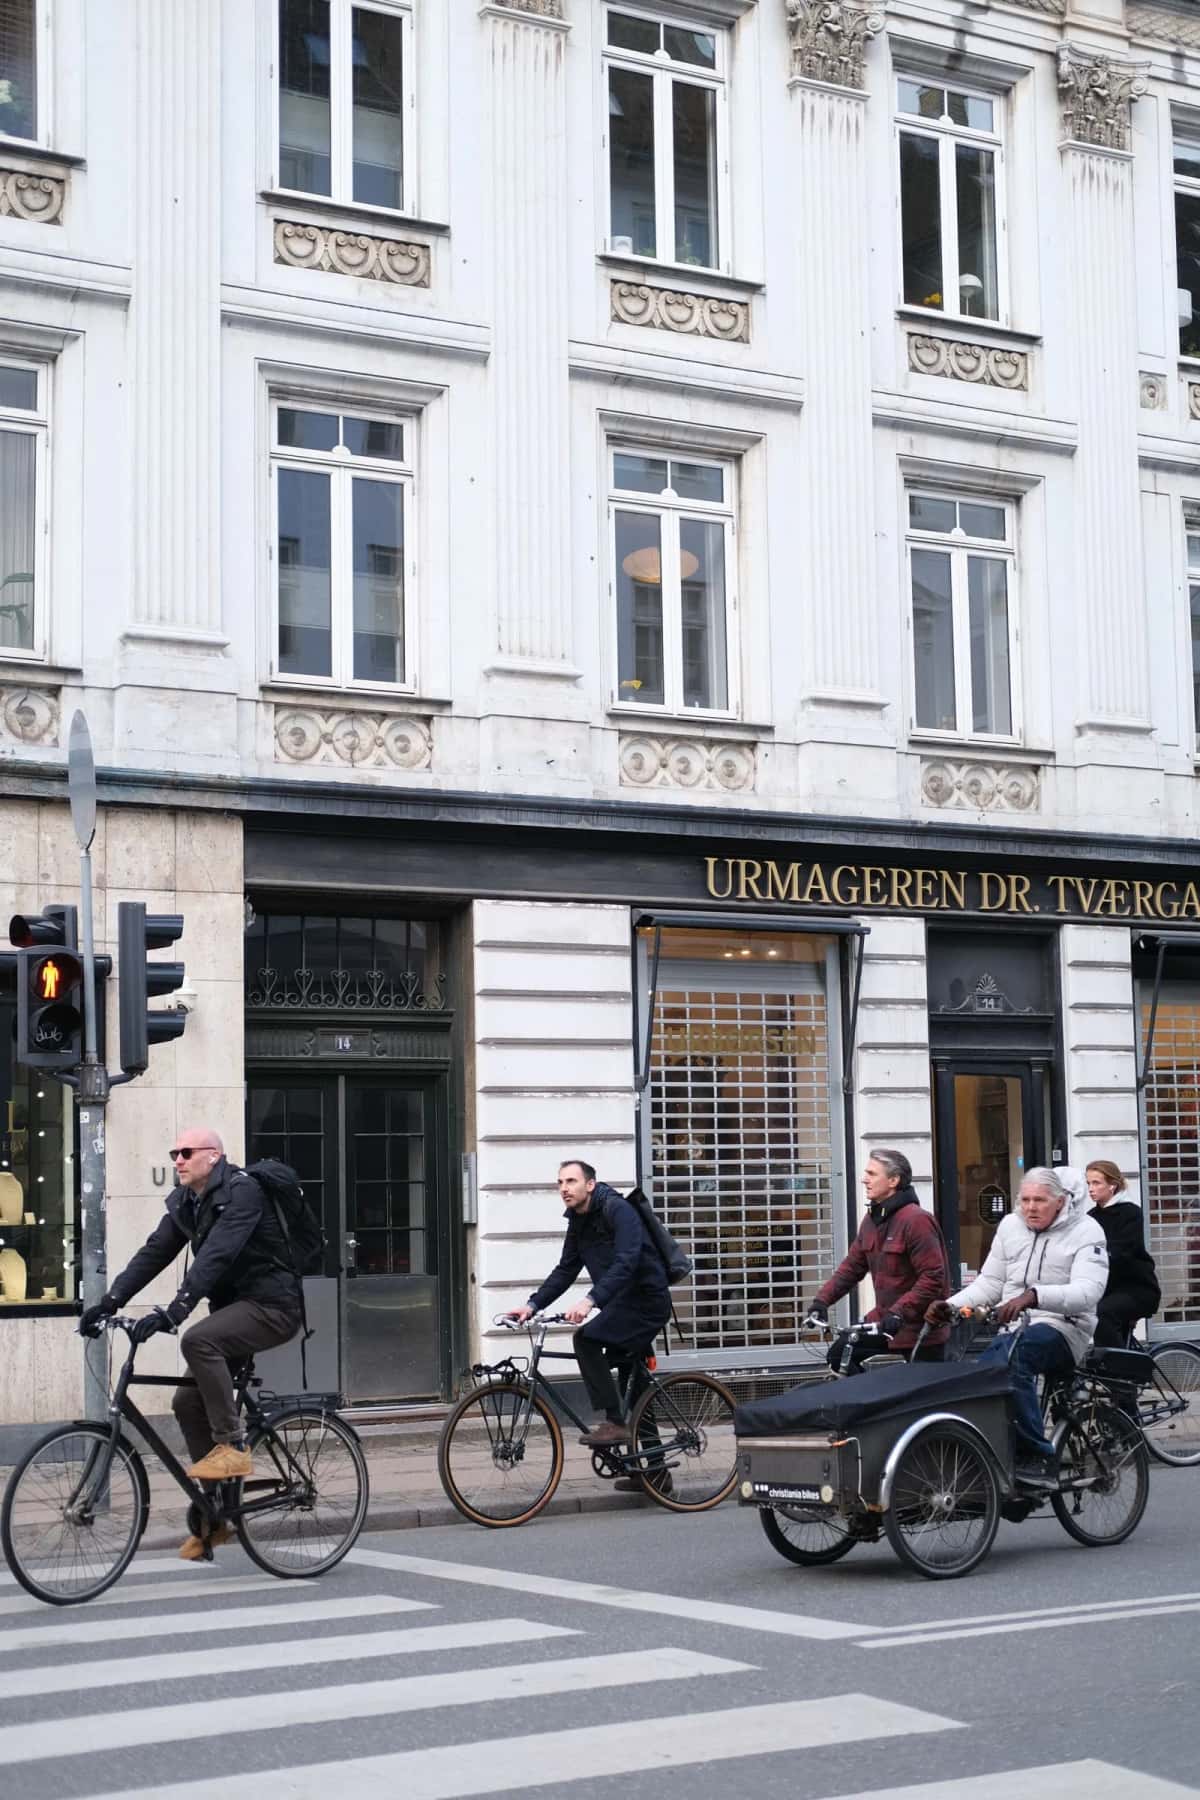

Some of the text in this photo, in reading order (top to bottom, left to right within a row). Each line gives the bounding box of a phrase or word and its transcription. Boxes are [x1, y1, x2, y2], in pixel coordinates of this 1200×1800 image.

[704, 857, 1200, 919] URMAGEREN DR. TVÆRGA
[982, 998, 995, 1009] 14
[338, 1037, 351, 1050] 14
[769, 1487, 820, 1500] christiania bikes
